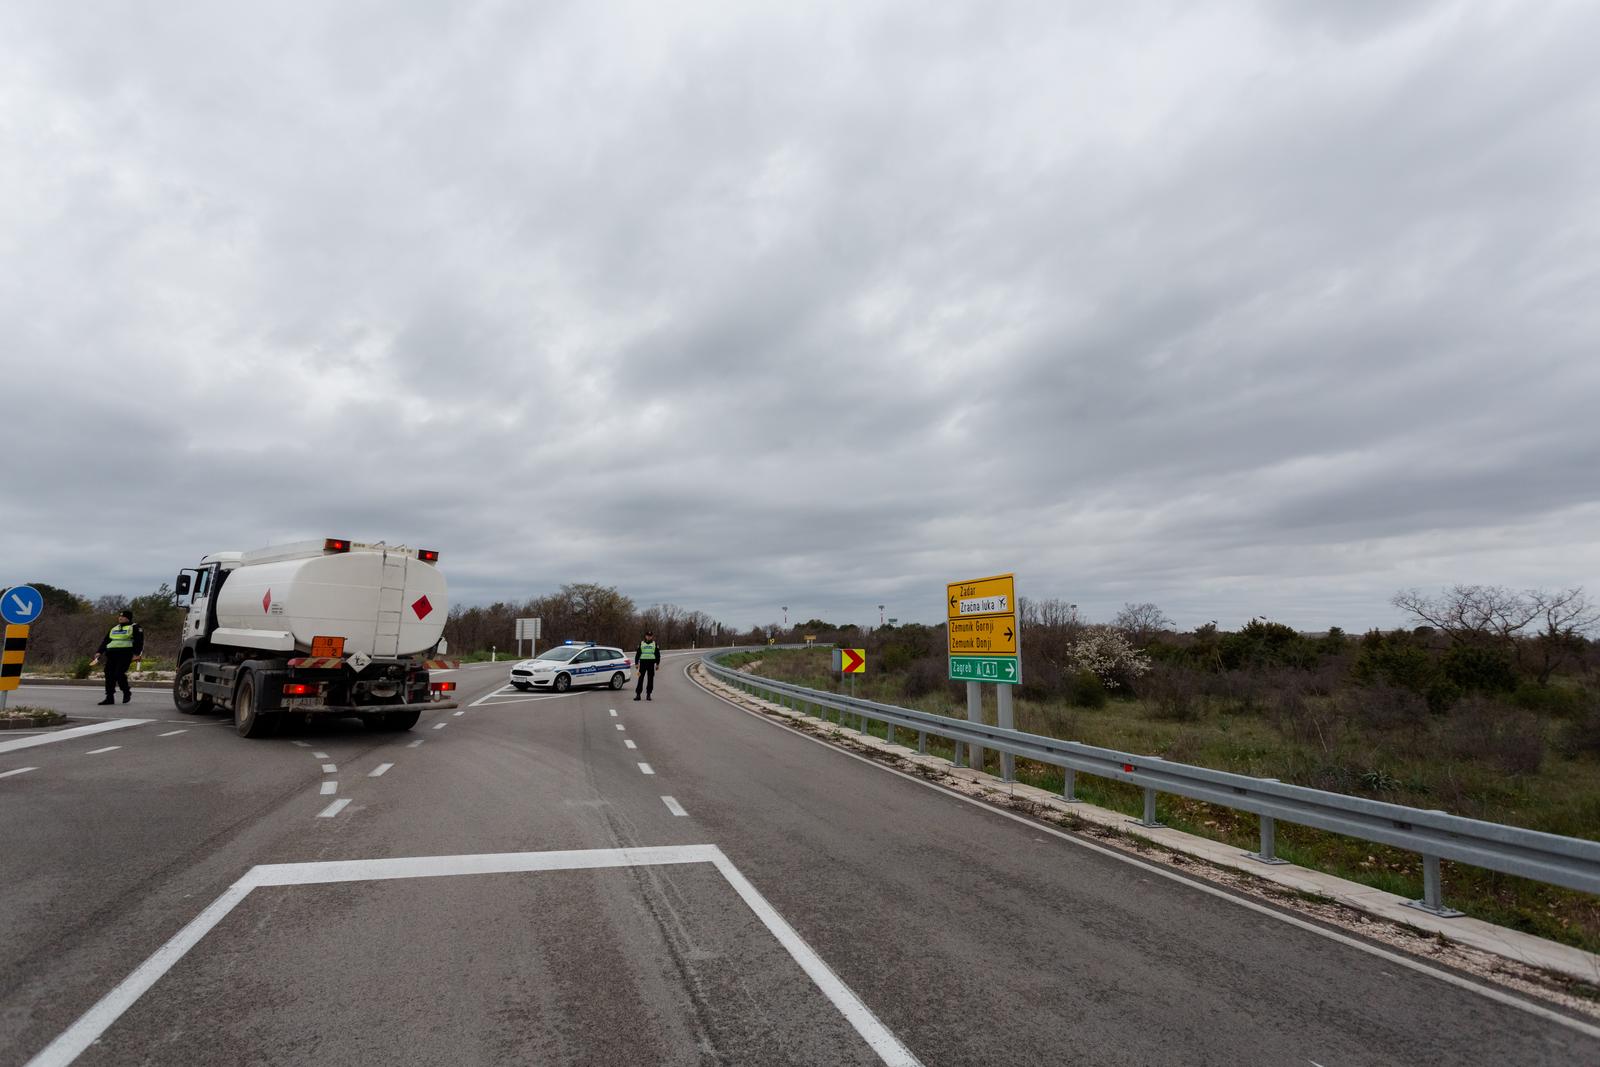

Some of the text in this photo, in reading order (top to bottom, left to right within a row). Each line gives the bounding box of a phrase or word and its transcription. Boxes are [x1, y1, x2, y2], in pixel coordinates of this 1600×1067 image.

[960, 586, 976, 597] Zadar
[960, 600, 995, 612] Zračna luka
[951, 620, 994, 633] Zemunik Gornji
[952, 637, 992, 650] Zemunik Donji
[953, 661, 972, 675] Zagreb
